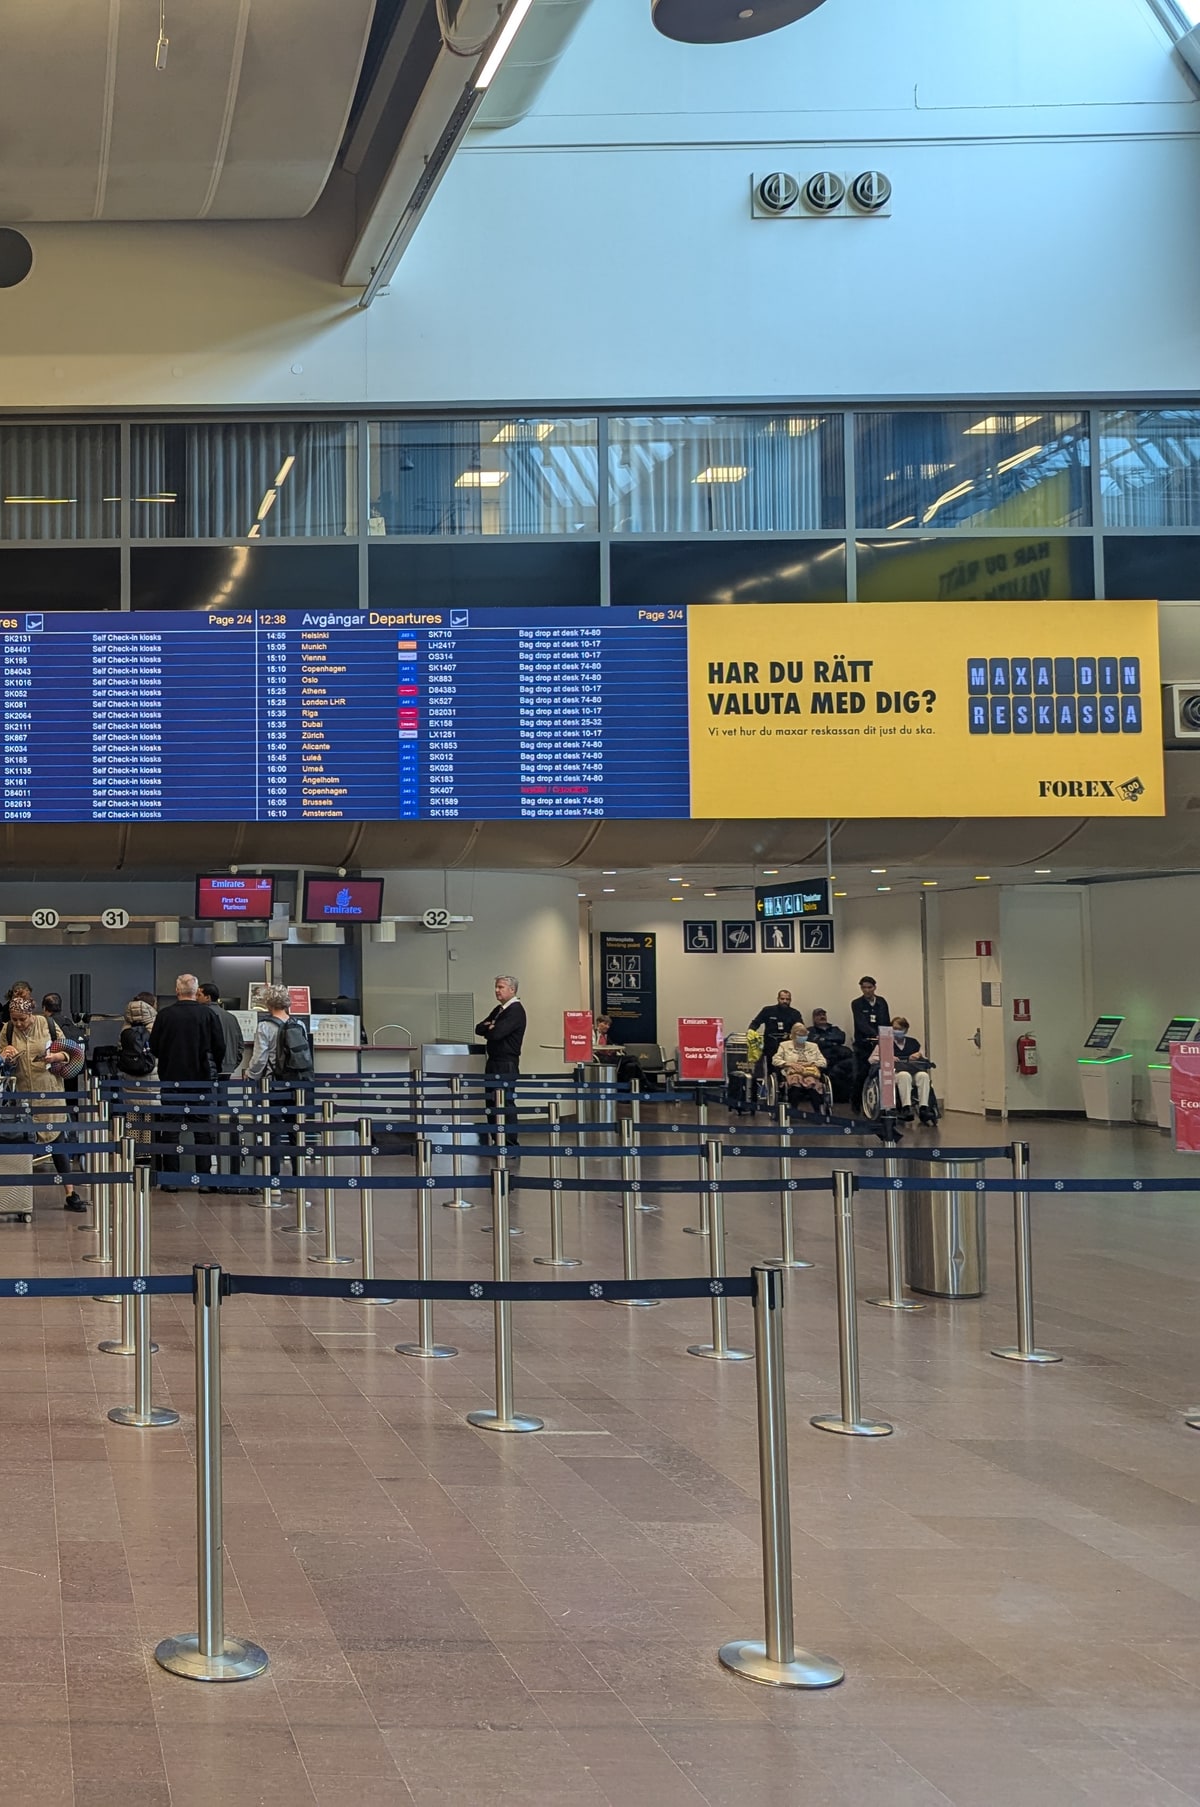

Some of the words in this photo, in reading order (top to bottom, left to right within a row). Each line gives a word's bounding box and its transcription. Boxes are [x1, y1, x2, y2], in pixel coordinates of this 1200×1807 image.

[208, 615, 234, 626] Page
[237, 615, 252, 624] 2/4
[259, 614, 287, 624] 12:38
[302, 613, 365, 627] Avgångar
[369, 612, 442, 627] Departures
[638, 610, 665, 622] Page
[667, 610, 683, 619] 3/4
[4, 635, 32, 643] SK2131
[266, 632, 286, 640] 14:55
[519, 630, 533, 638] Bag
[266, 643, 286, 651] 15:05
[519, 641, 533, 649] Bag
[535, 641, 551, 649] drop
[92, 656, 107, 664] Self
[140, 656, 162, 664] kiosks
[708, 662, 760, 684] HAR
[769, 661, 803, 683] DU
[814, 654, 874, 683] RÄTT
[971, 667, 1049, 687] MAXA
[1081, 666, 1137, 686] DIN
[708, 692, 802, 715] VALUTA
[811, 691, 866, 714] MED
[876, 689, 937, 714] DIG?
[974, 706, 1137, 725] RESKASSA
[708, 727, 719, 736] Vi
[722, 727, 737, 736] vet
[740, 727, 757, 736] hur
[760, 726, 772, 735] du
[811, 726, 860, 735] reskassan
[863, 726, 876, 735] dit
[879, 726, 897, 737] just
[899, 726, 912, 735] du
[915, 725, 935, 735] ska.
[1038, 781, 1115, 797] FOREX
[211, 880, 245, 888] Emirates
[324, 906, 362, 914] Emirates
[35, 911, 56, 926] 30
[105, 911, 126, 926] 31
[426, 911, 448, 926] 32
[644, 937, 653, 948] 2
